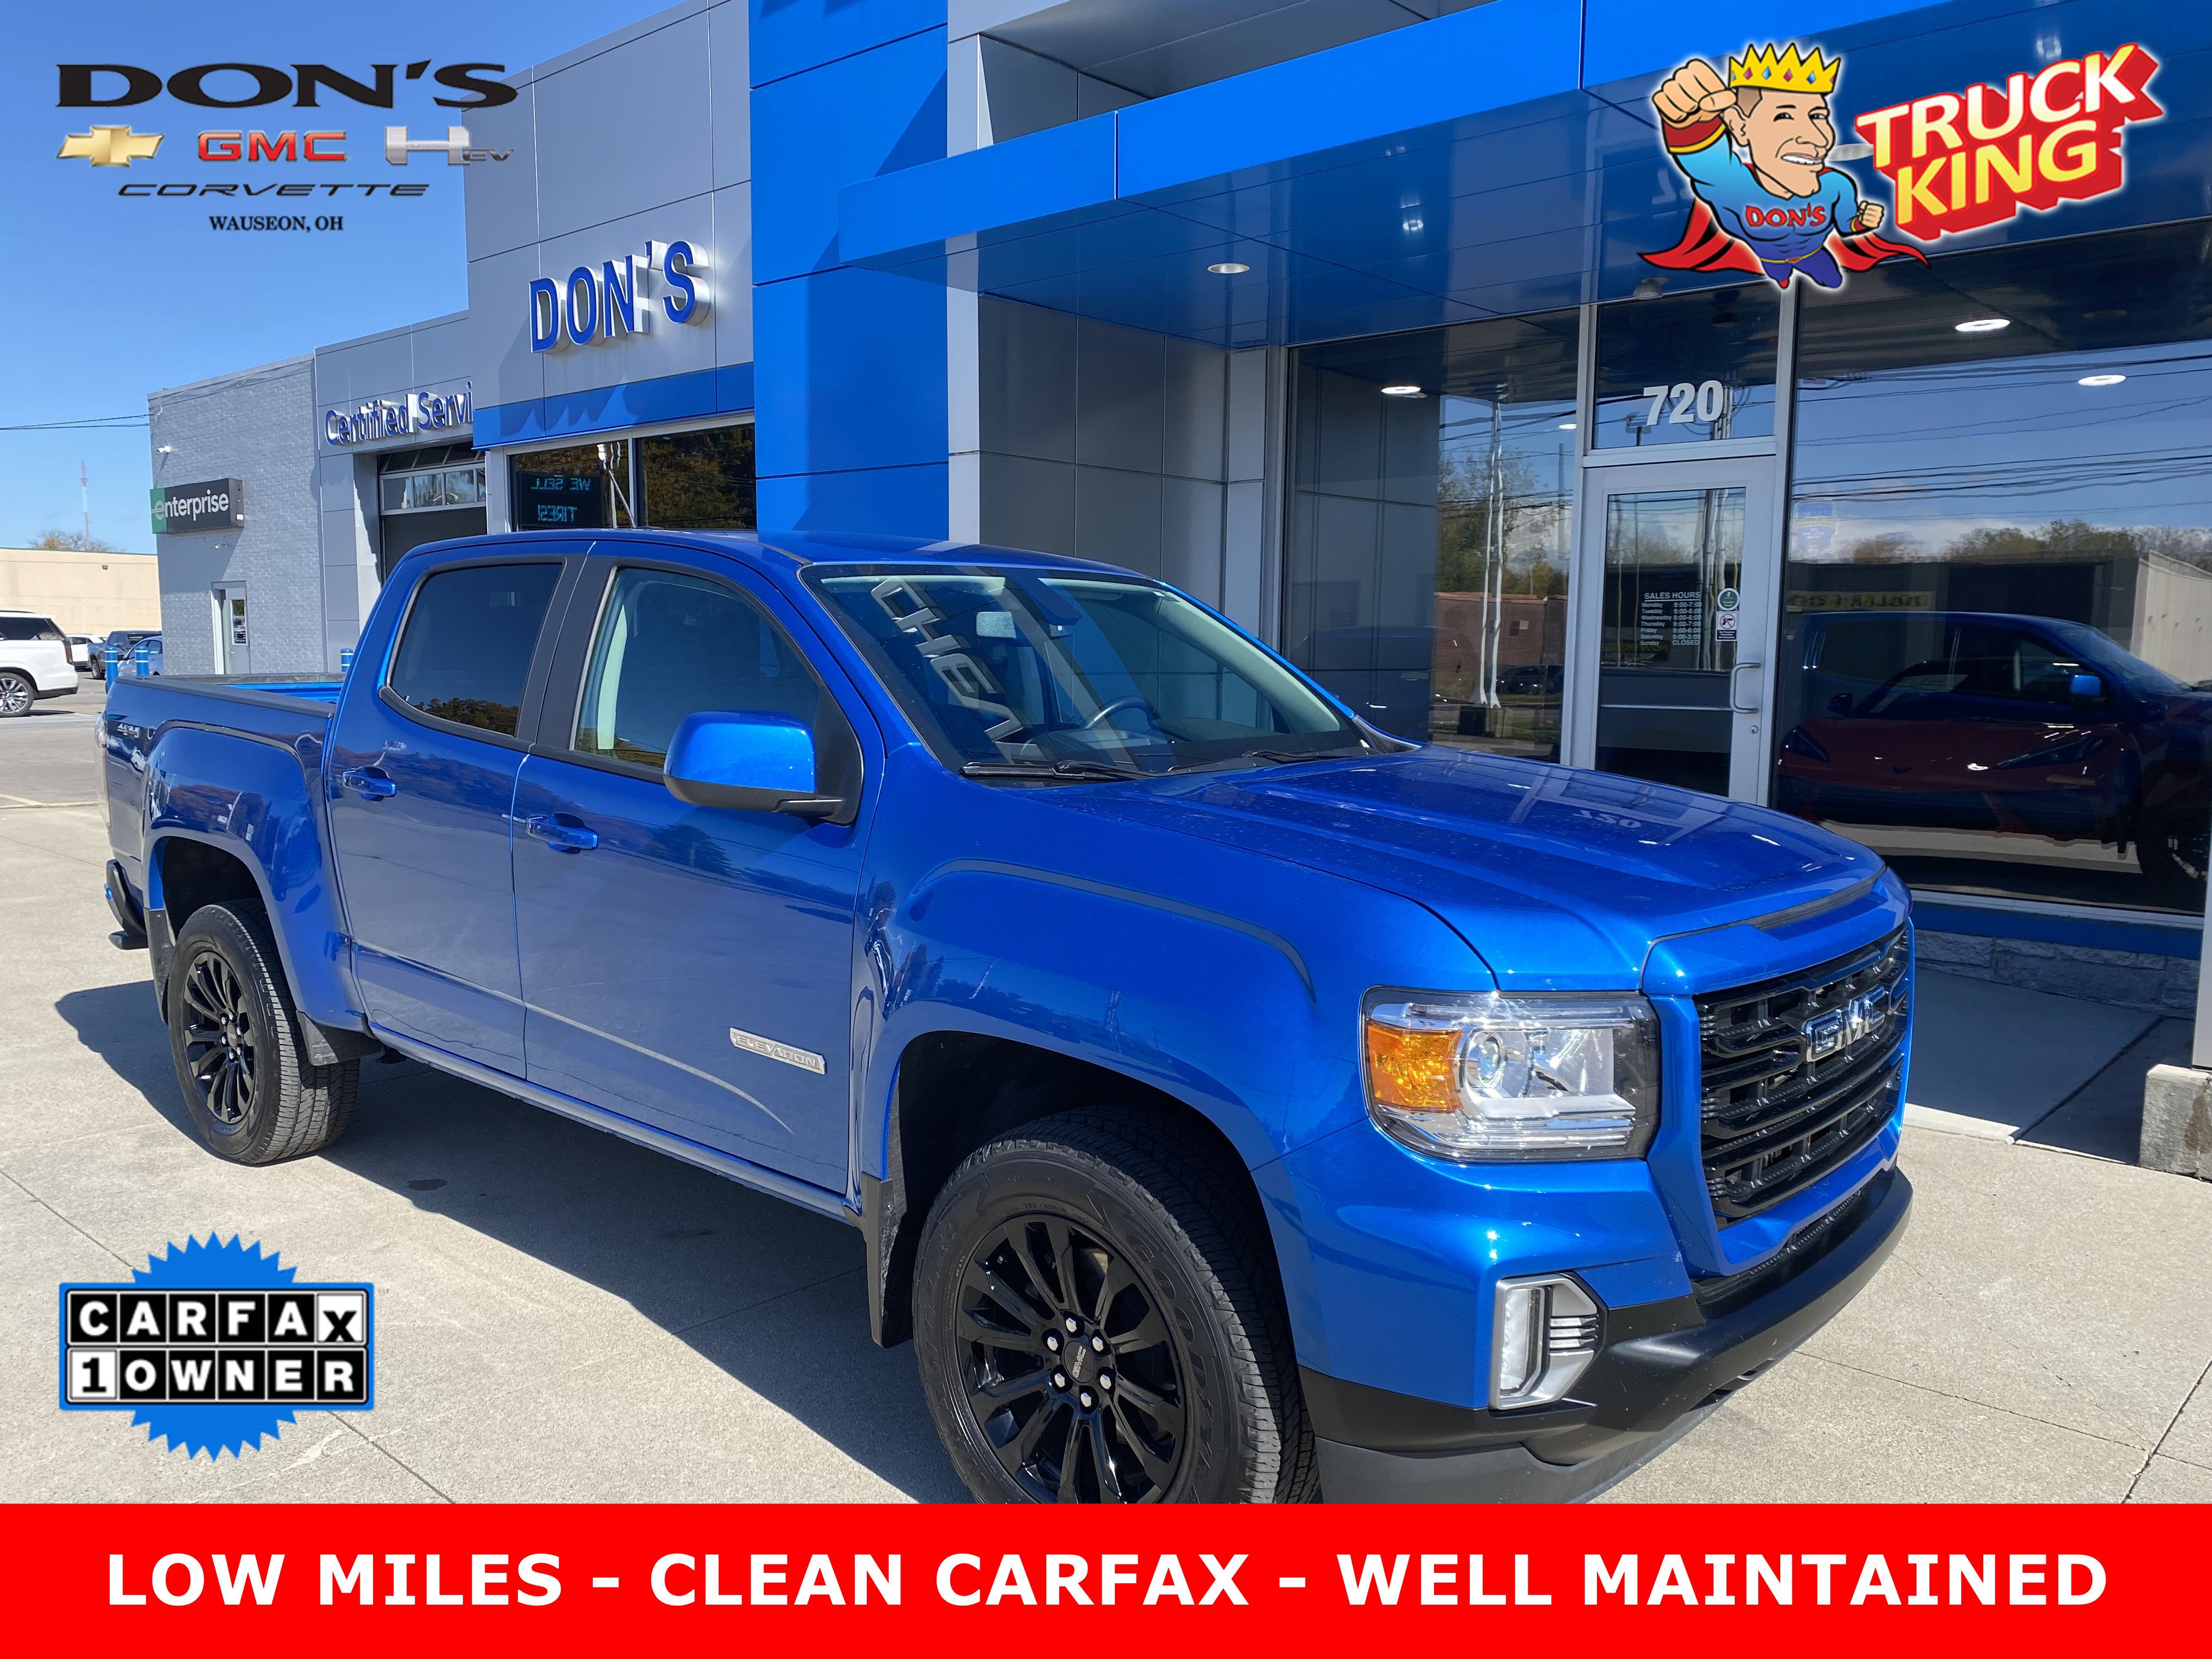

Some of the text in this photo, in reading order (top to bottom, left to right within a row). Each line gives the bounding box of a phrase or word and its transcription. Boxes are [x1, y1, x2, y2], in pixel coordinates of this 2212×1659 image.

[529, 240, 709, 353] DON'S
[324, 393, 413, 445] Certified
[1643, 380, 1724, 426] 720
[151, 489, 229, 521] enterprise
[1802, 984, 1885, 1063] GMC
[737, 1035, 817, 1068] ELEVATION
[1072, 1345, 1086, 1378] GMC
